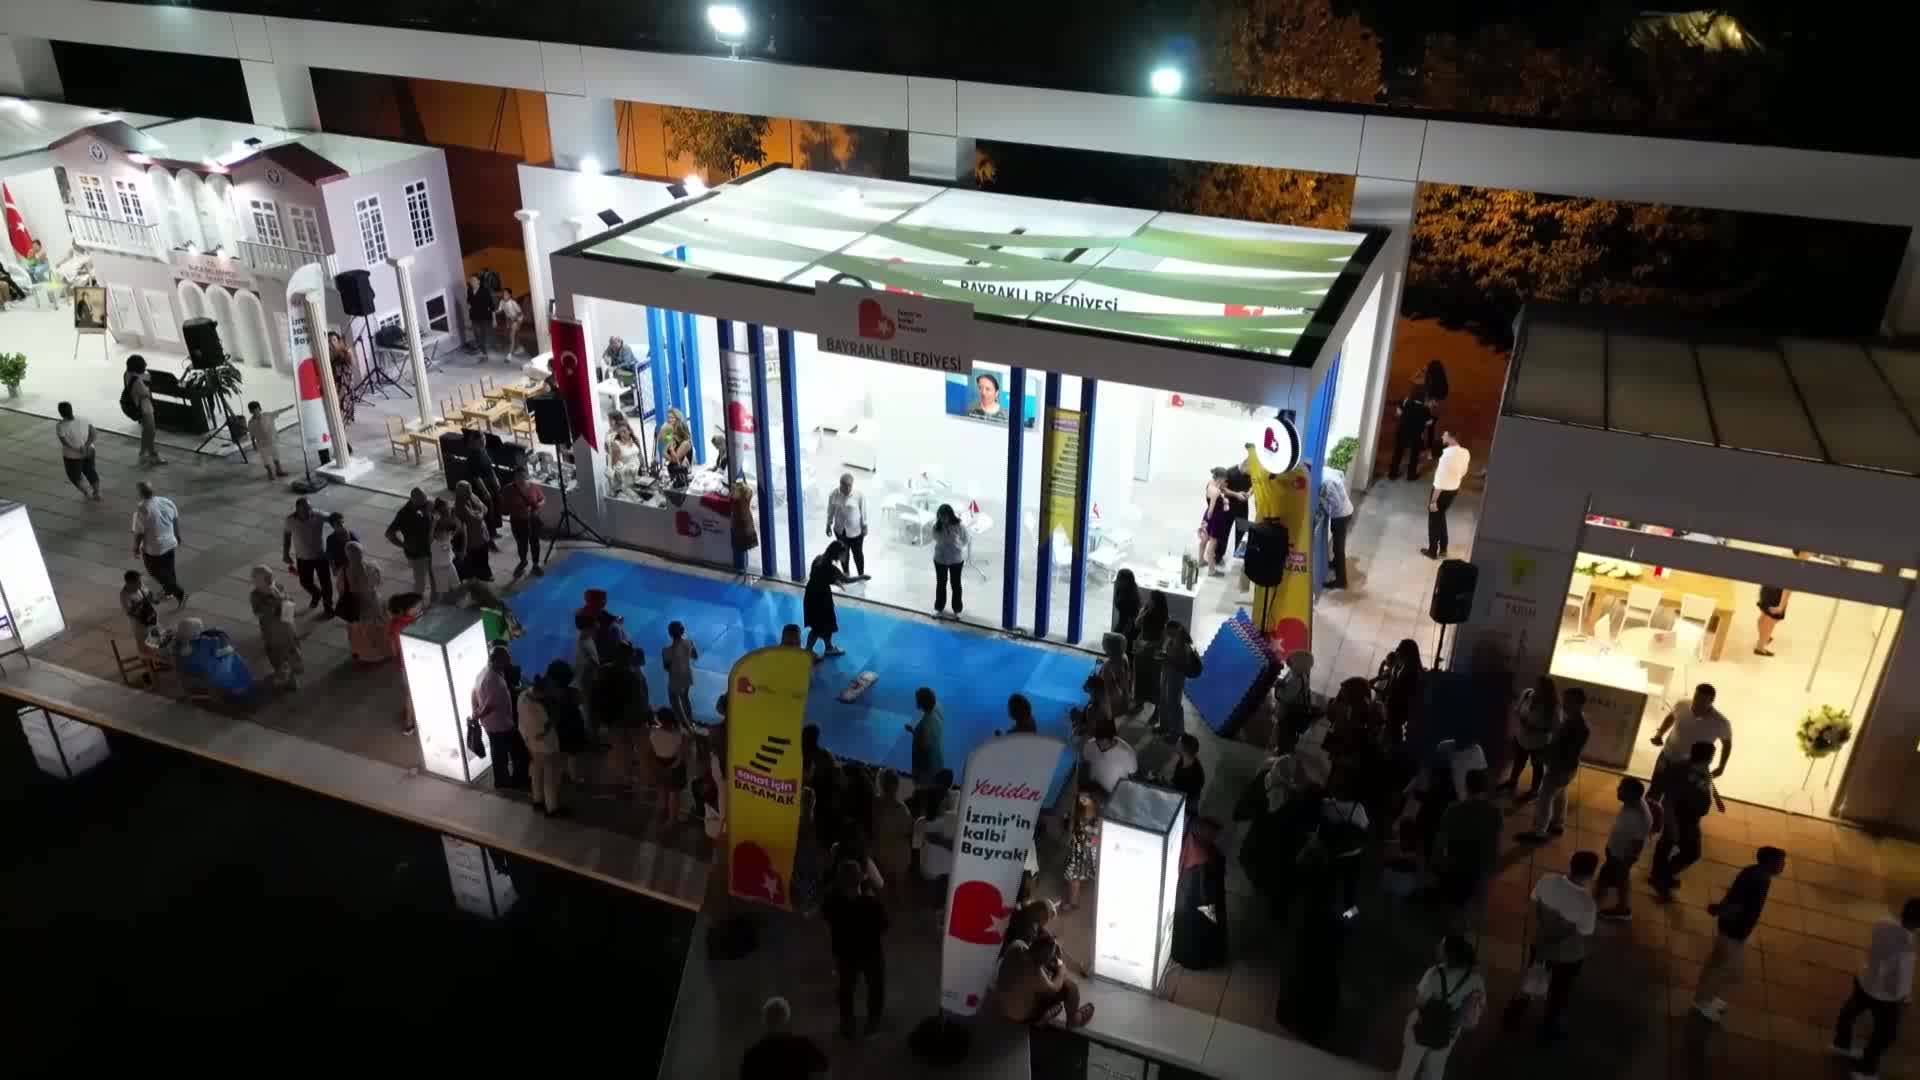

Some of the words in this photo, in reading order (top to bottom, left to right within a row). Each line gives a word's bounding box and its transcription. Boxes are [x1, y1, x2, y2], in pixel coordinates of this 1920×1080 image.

[1034, 290, 1118, 312] BEEDİYESİ
[826, 337, 885, 360] BAYRAKLI
[891, 347, 961, 371] BELEDİYESİ
[971, 776, 1042, 801] Yeniden
[966, 805, 1031, 830] İzmir'in
[963, 825, 1006, 842] kalbi
